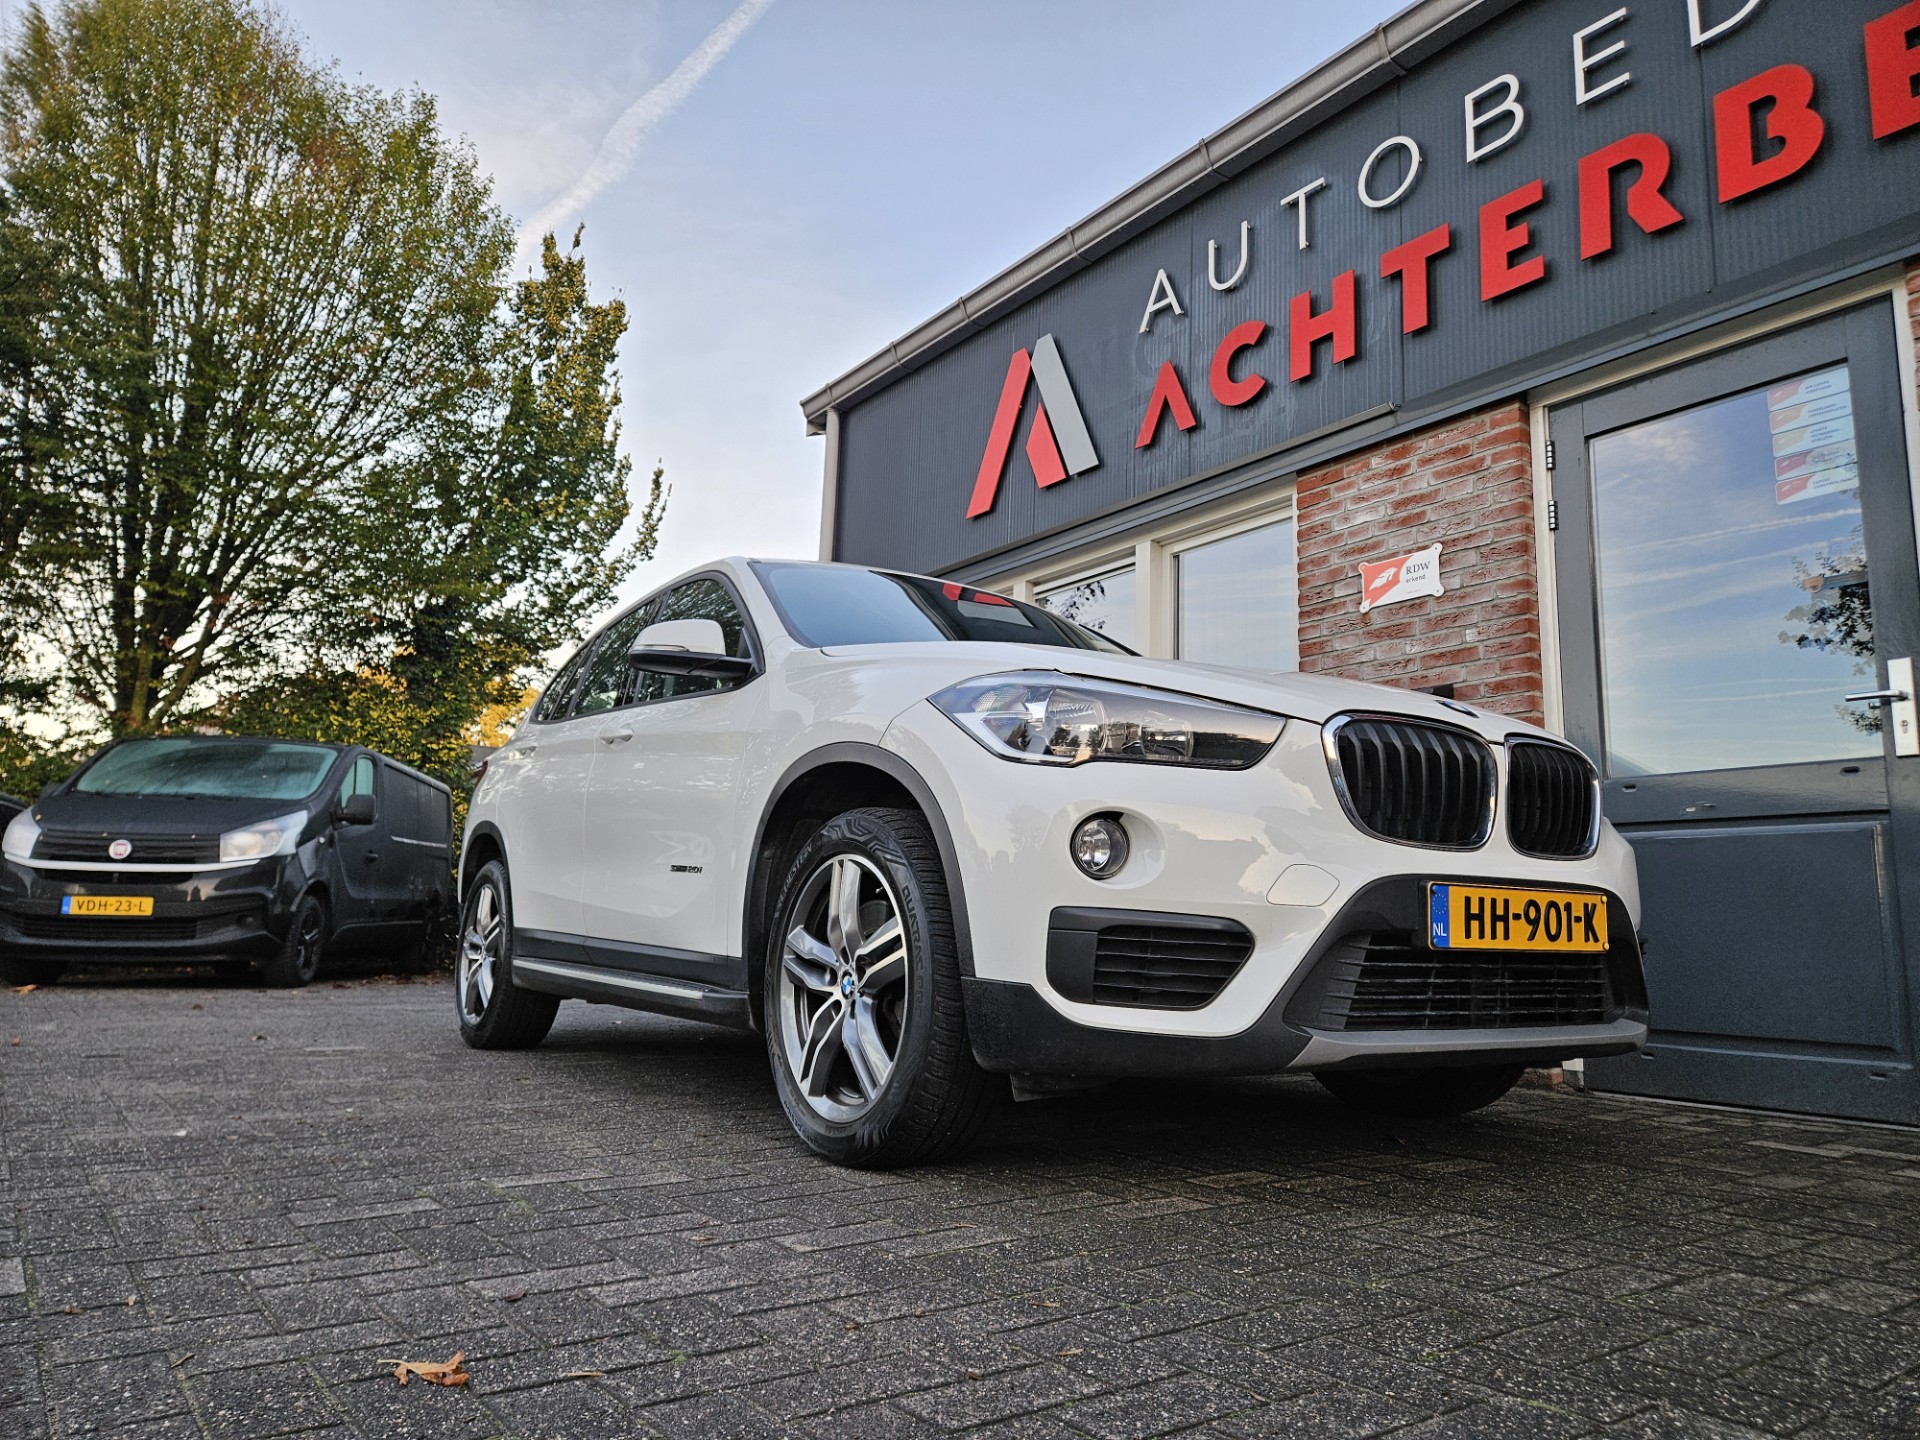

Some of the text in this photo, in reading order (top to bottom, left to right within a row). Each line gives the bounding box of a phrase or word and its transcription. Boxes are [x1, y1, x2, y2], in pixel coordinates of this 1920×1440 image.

[1405, 561, 1431, 575] RDW
[76, 900, 146, 913] VDH-23-L
[1464, 895, 1600, 944] HH-901-K
[1432, 923, 1448, 937] NL
